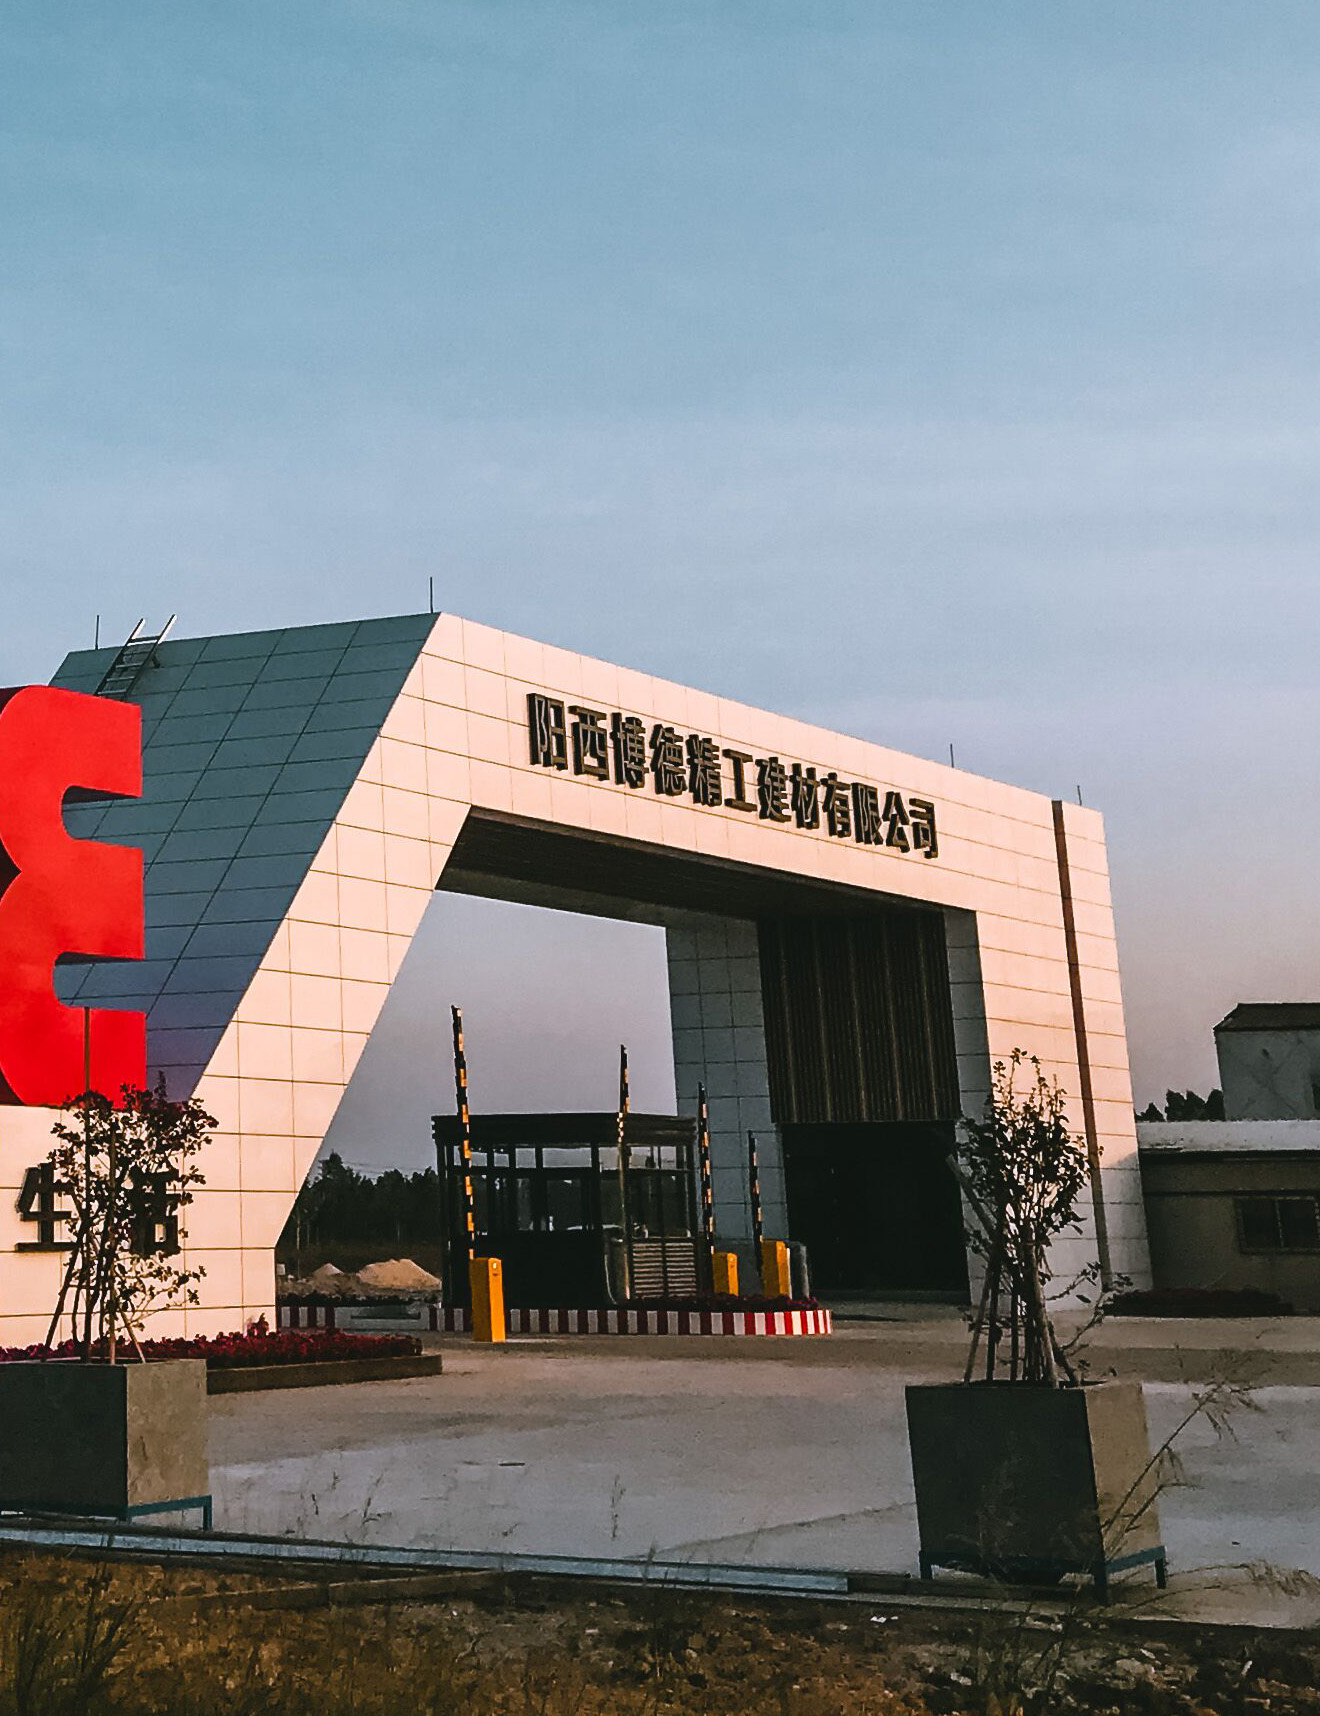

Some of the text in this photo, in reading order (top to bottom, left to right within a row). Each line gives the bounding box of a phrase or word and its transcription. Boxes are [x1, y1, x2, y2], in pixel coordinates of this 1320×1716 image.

[526, 692, 938, 858] 阳西博德精工建材有限公司
